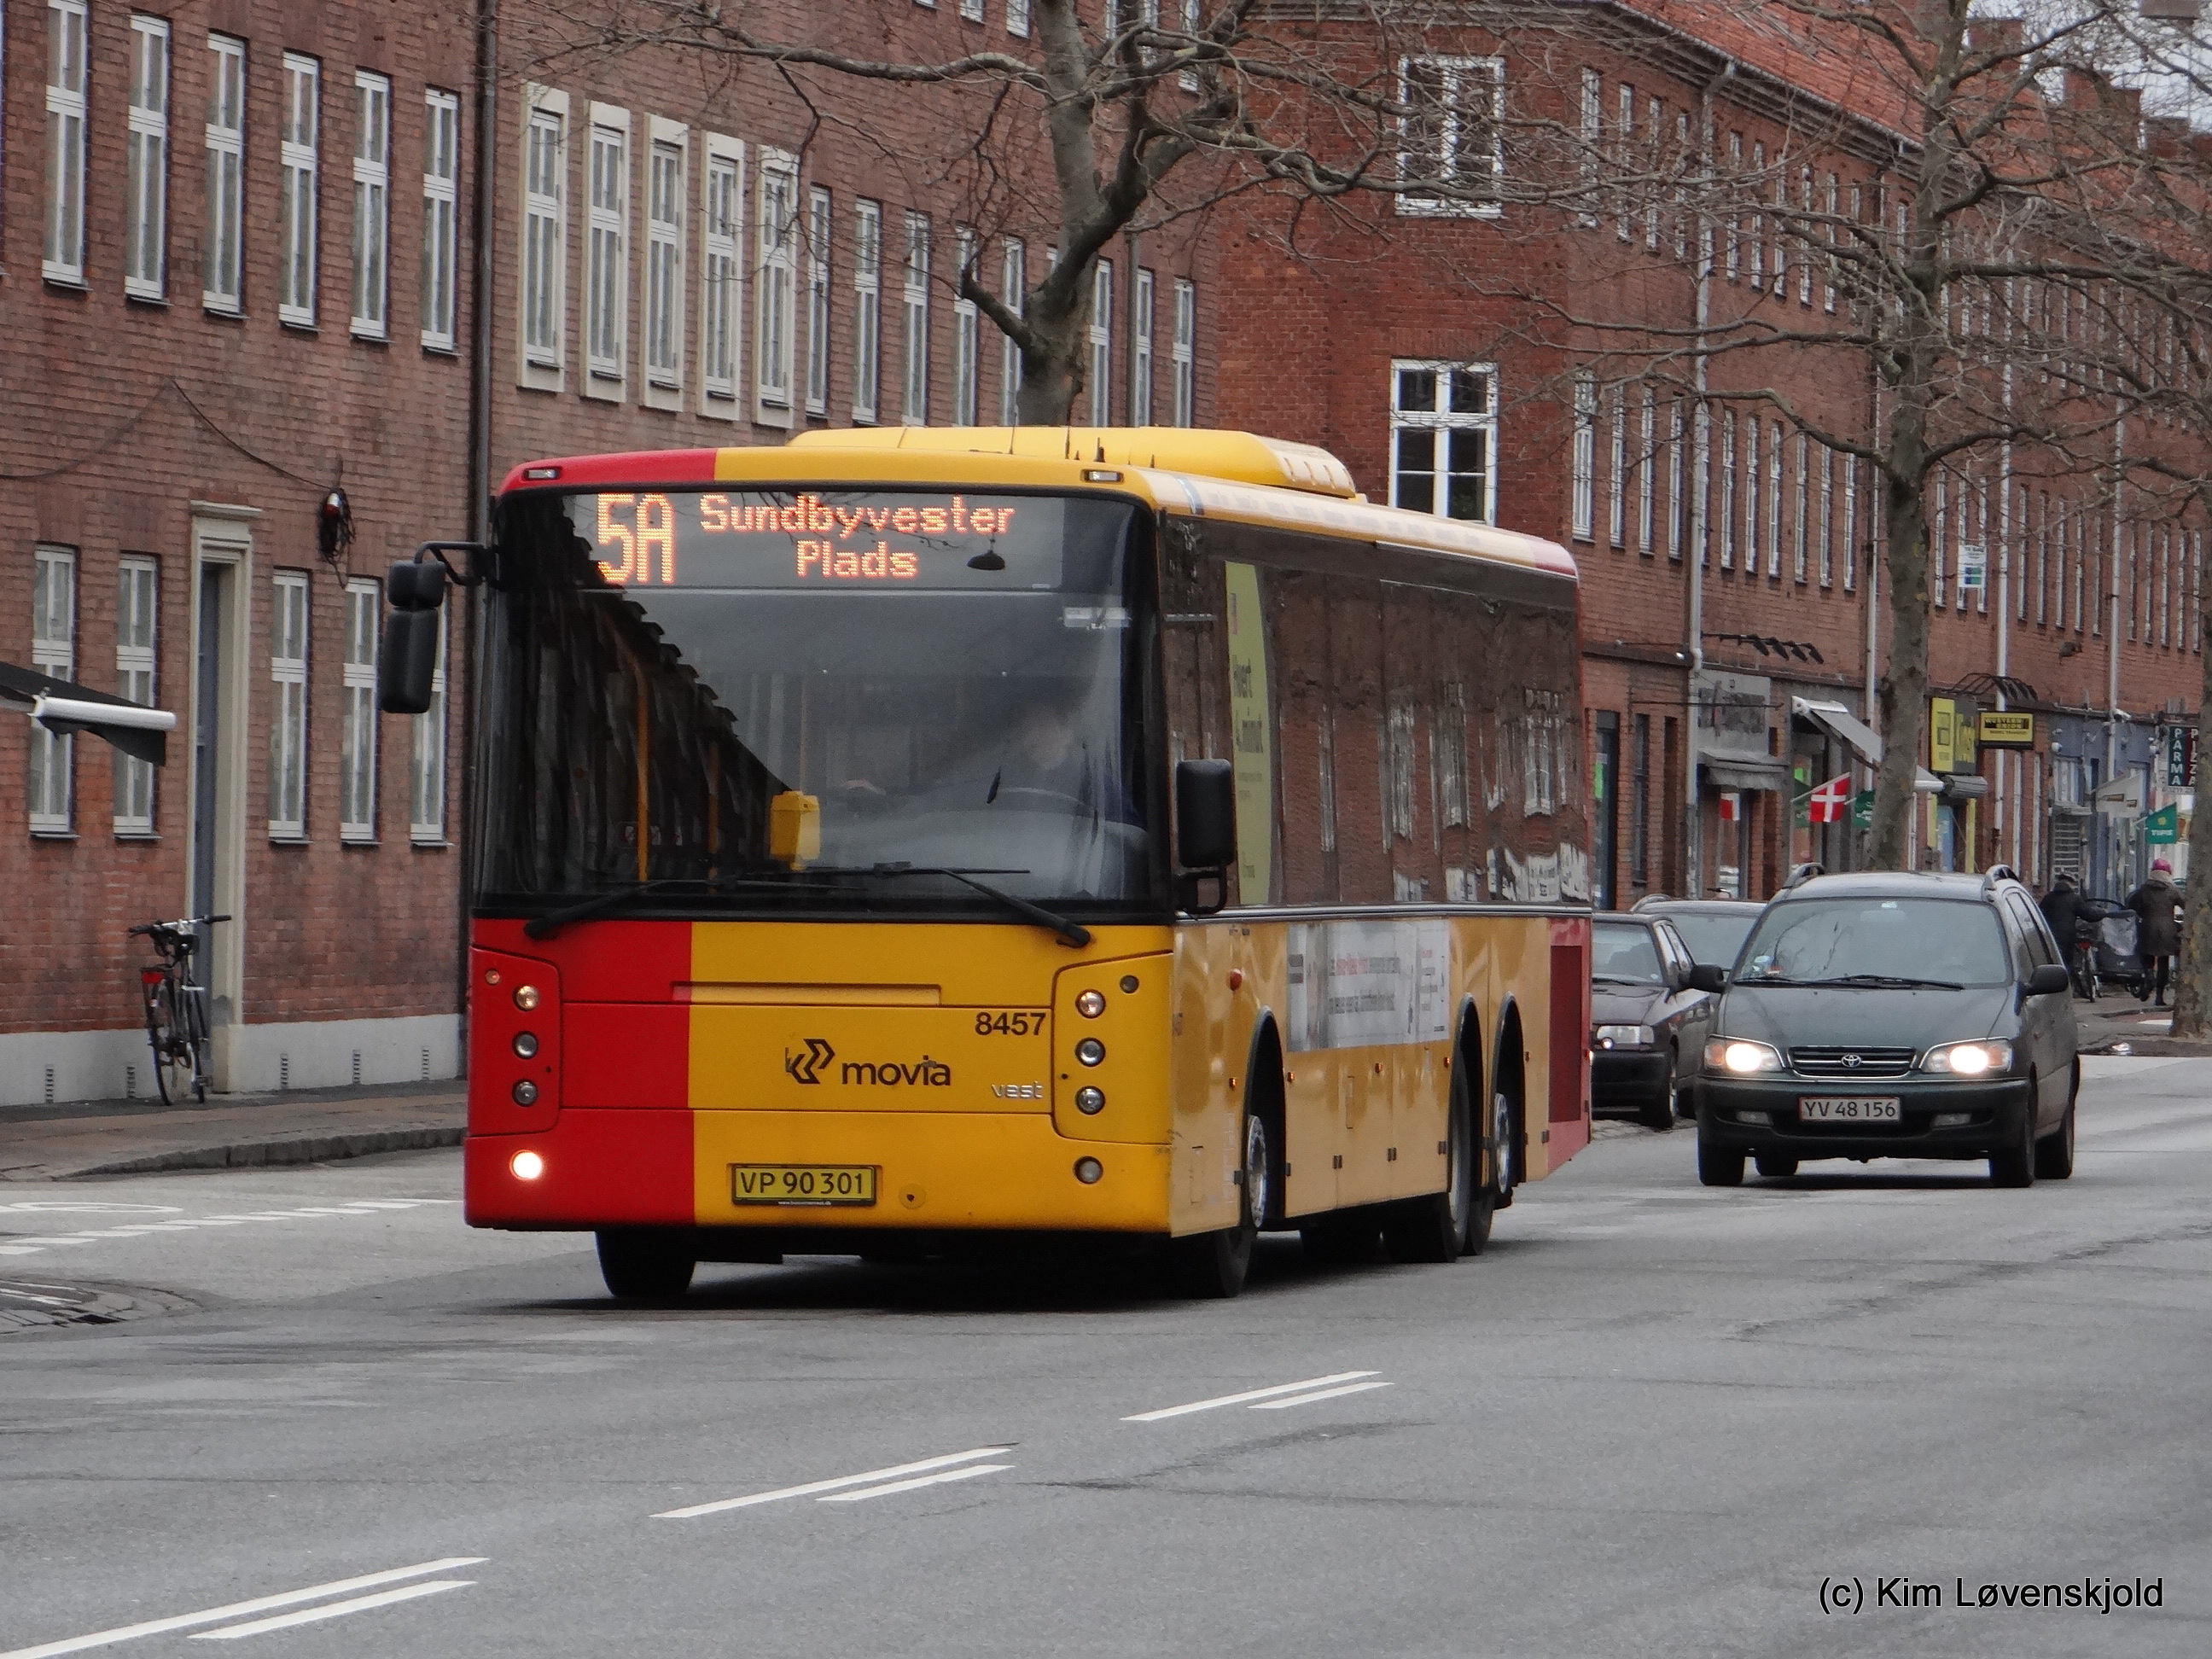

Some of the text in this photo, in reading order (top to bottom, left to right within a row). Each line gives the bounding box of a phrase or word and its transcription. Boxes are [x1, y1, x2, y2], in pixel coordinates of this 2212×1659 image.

[699, 494, 1015, 538] Sundbyvester
[597, 492, 674, 585] 5A
[795, 539, 918, 579] Plads
[2170, 728, 2183, 785] PARMA
[2187, 728, 2198, 785] PIZZA
[975, 1012, 1046, 1036] 8457
[841, 1055, 952, 1086] movia
[1804, 1101, 1896, 1118] YV 48 156
[740, 1171, 863, 1195] VP 90 301
